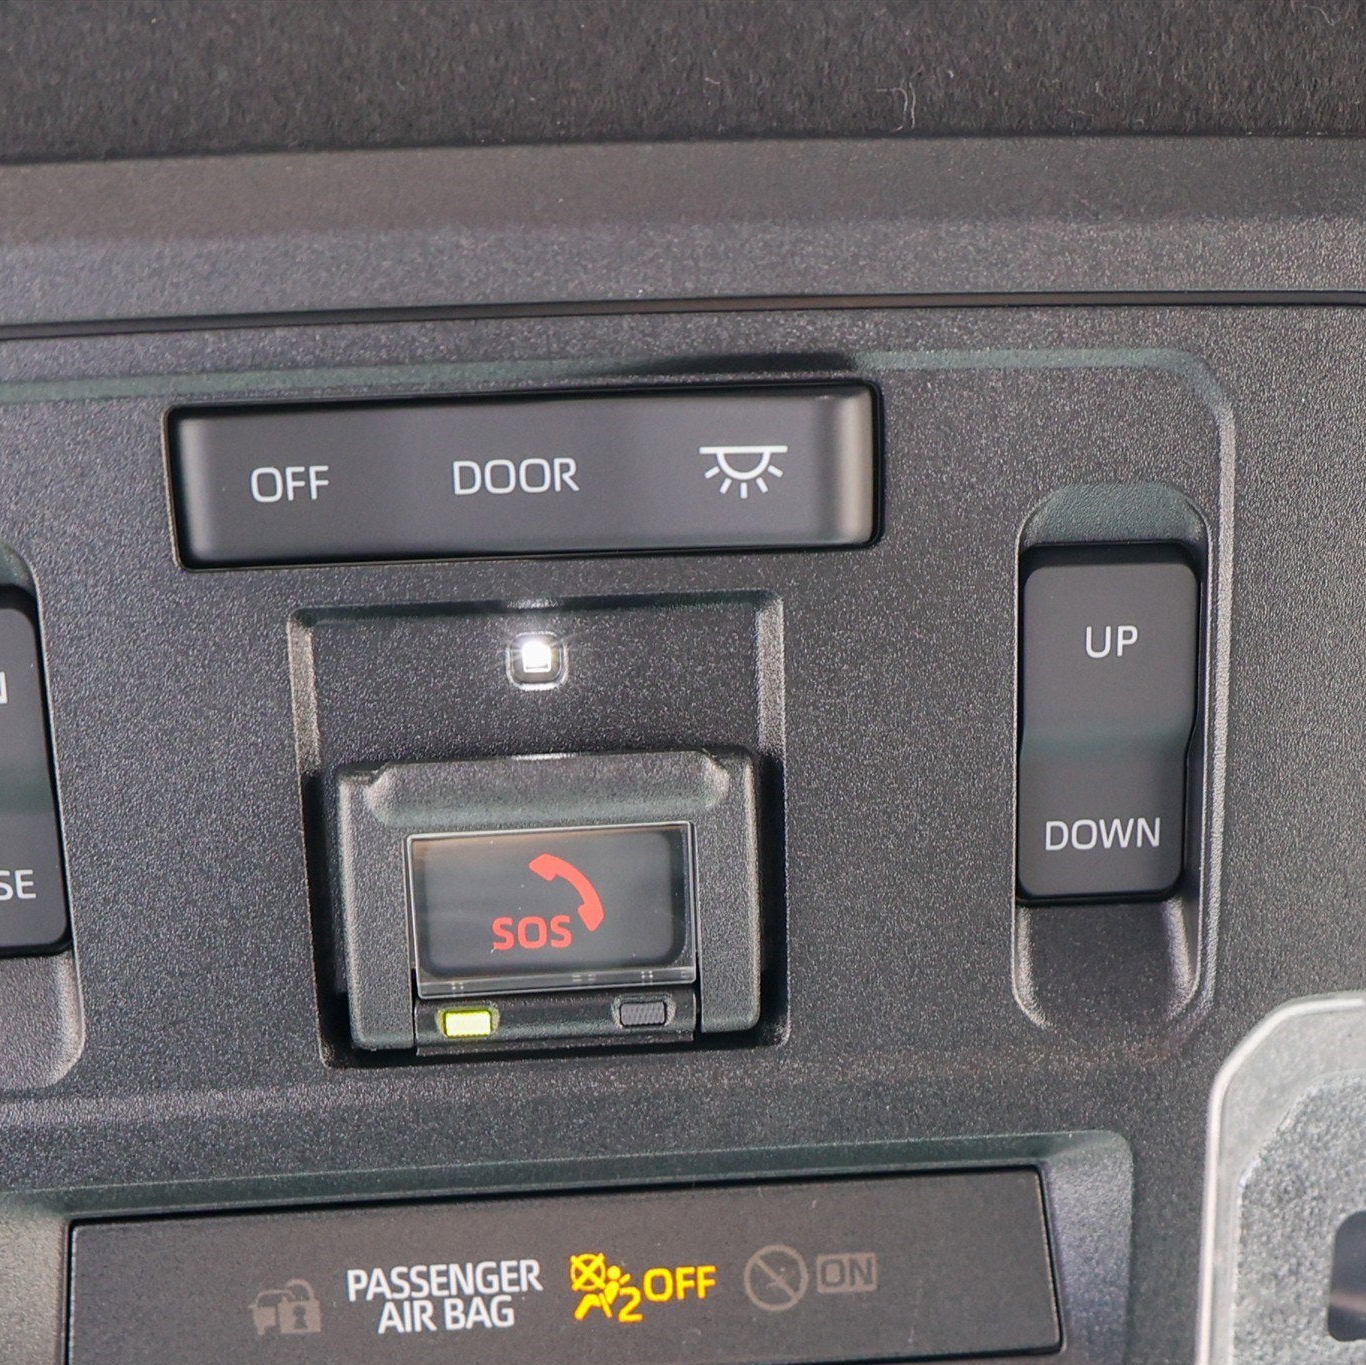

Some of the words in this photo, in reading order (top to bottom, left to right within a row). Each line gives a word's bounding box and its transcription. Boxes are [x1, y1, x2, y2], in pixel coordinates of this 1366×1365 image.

[250, 465, 329, 503] OFF
[453, 457, 580, 495] DOOR
[1085, 625, 1138, 659] UP
[1045, 817, 1160, 851] DOWN
[492, 915, 572, 951] SOS
[347, 1259, 544, 1303] PASSENGER
[643, 1265, 717, 1302] OFF
[820, 1255, 876, 1292] ON
[377, 1301, 437, 1335] AIR
[443, 1295, 515, 1331] BAG
